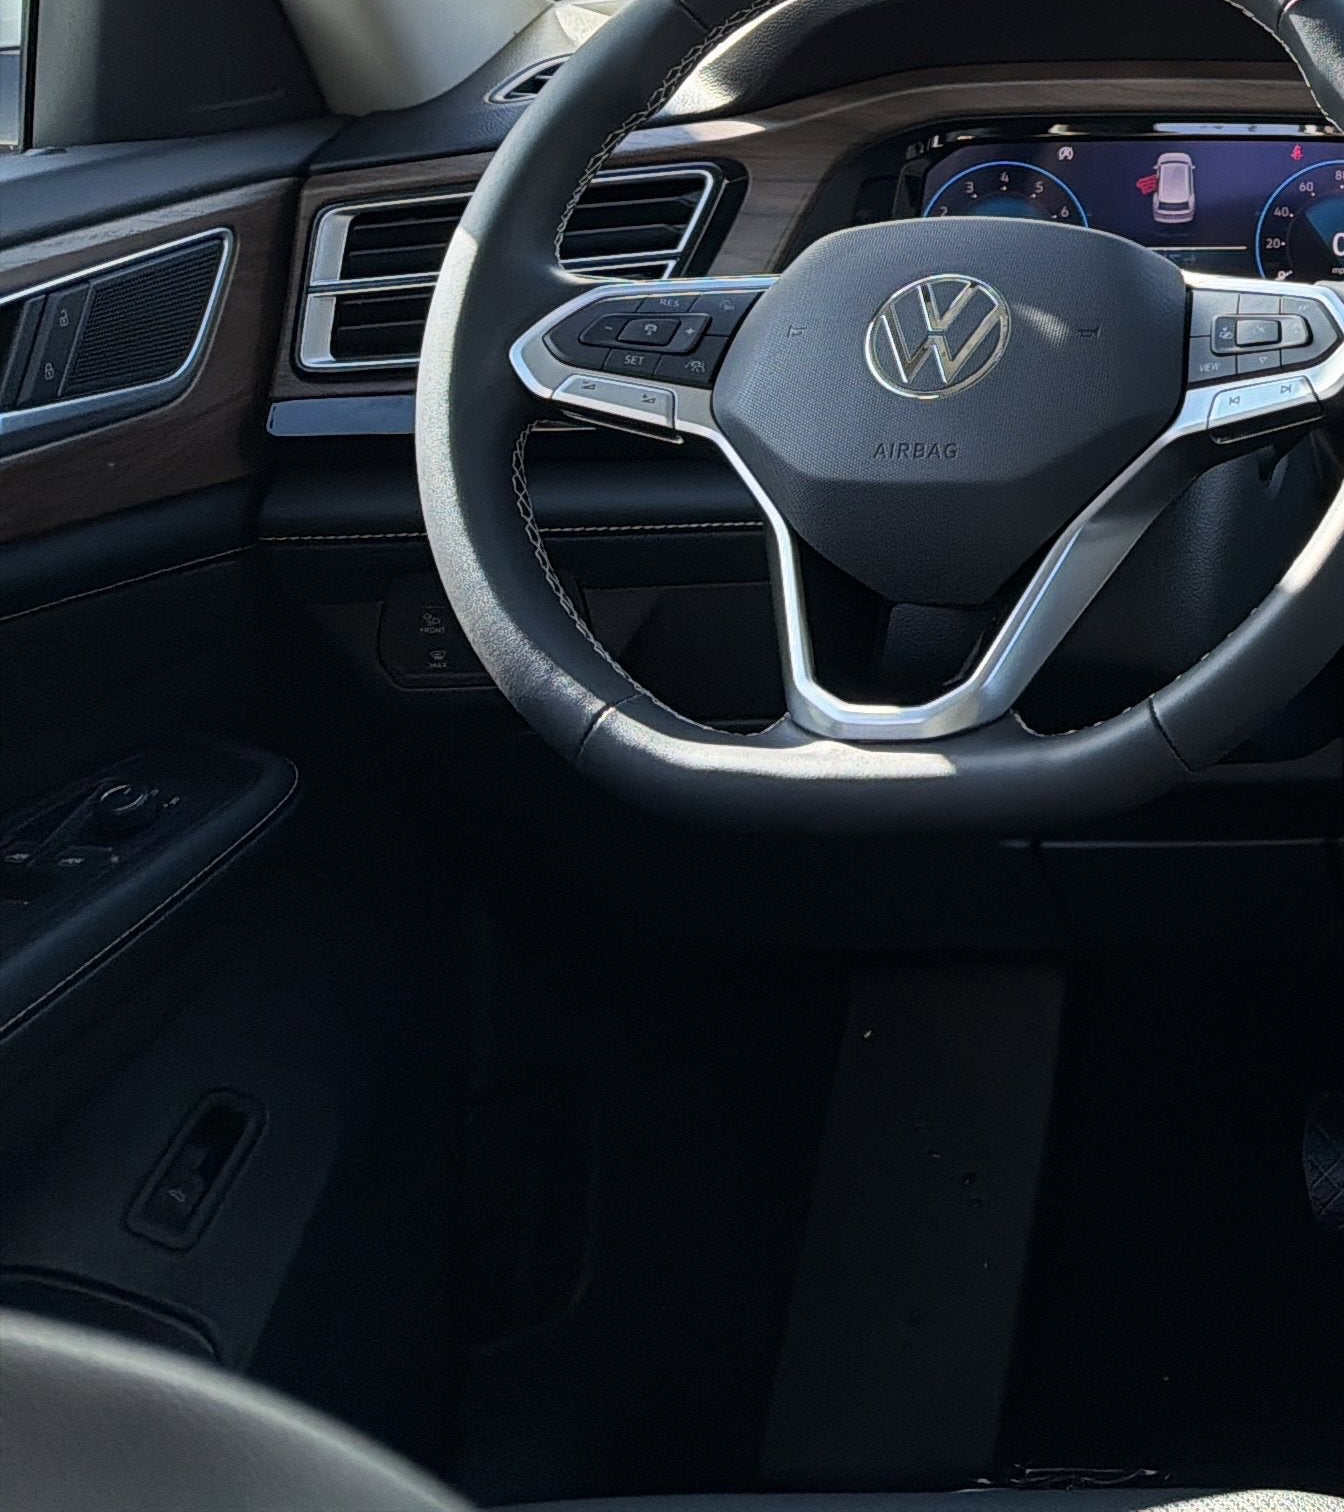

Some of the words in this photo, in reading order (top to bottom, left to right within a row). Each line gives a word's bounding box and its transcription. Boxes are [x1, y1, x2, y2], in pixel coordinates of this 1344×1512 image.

[999, 171, 1010, 184] 4
[964, 181, 975, 194] 3
[1035, 180, 1045, 194] 5
[1298, 181, 1314, 193] 60
[1060, 205, 1070, 218] 6
[1273, 206, 1290, 218] 40
[1265, 238, 1282, 249] 20
[659, 298, 681, 308] RES
[623, 354, 647, 367] SET
[872, 442, 961, 460] AIRBAG
